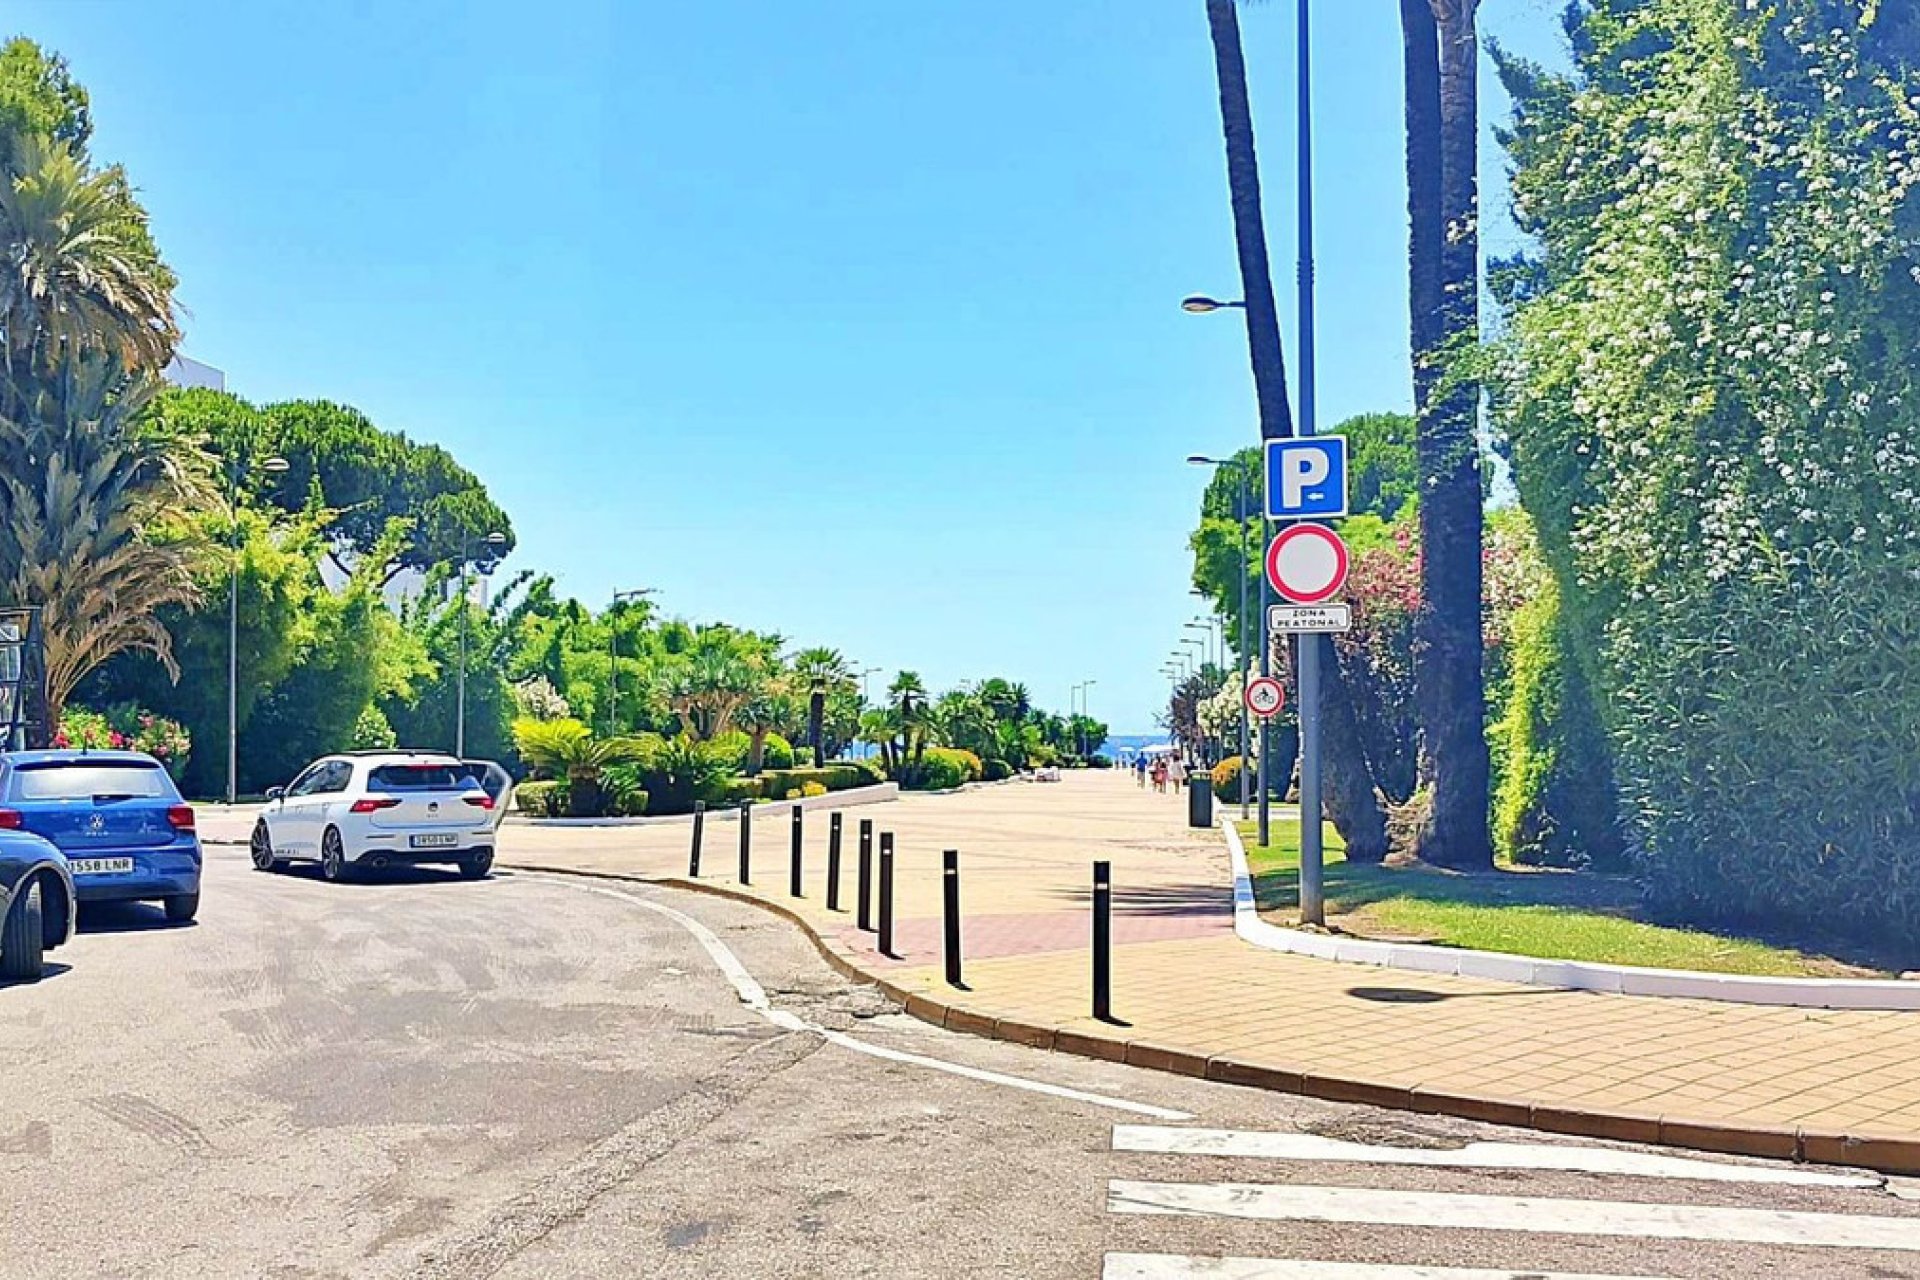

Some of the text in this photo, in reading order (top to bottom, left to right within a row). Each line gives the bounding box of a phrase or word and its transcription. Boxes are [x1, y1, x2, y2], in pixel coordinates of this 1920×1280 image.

[1282, 447, 1330, 509] P
[1293, 609, 1326, 617] ZONA
[1277, 619, 1340, 627] PEATONAL
